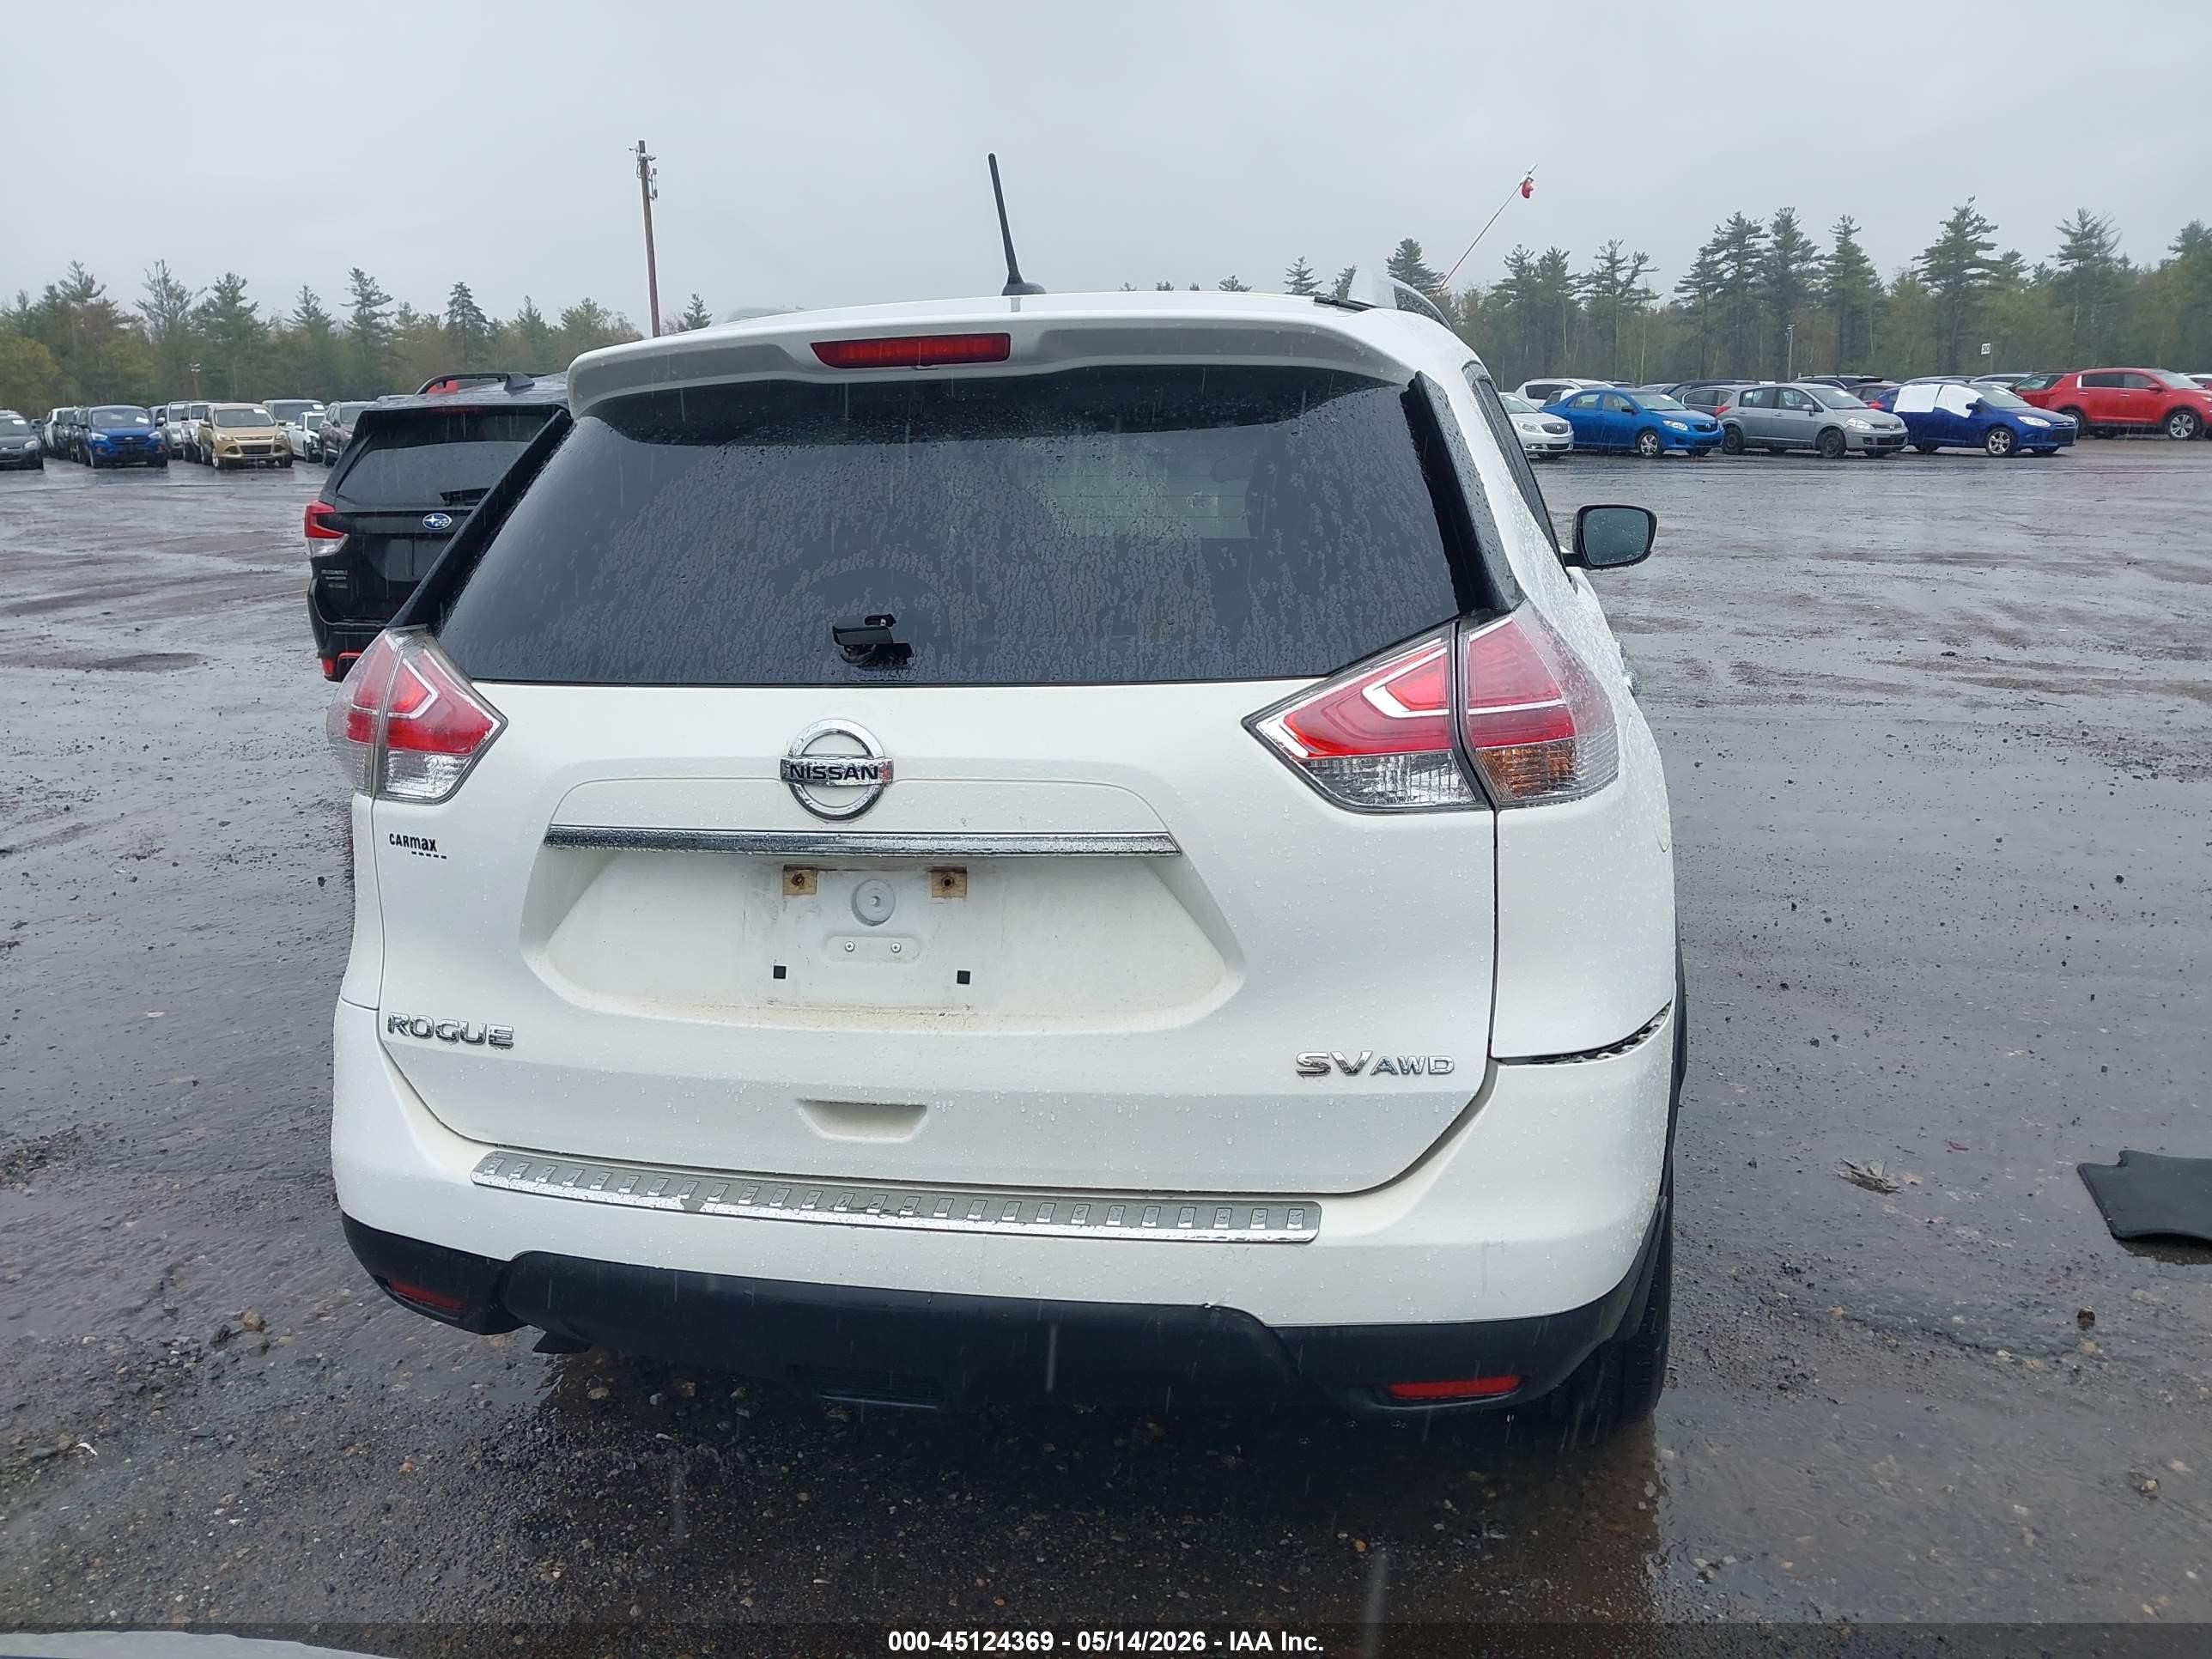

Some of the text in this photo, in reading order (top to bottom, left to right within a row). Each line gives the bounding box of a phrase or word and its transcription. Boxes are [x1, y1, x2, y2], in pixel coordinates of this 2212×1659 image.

[789, 764, 879, 780] NISSAN
[386, 1011, 514, 1050] ROGUE
[1296, 1050, 1455, 1076] SV AWD
